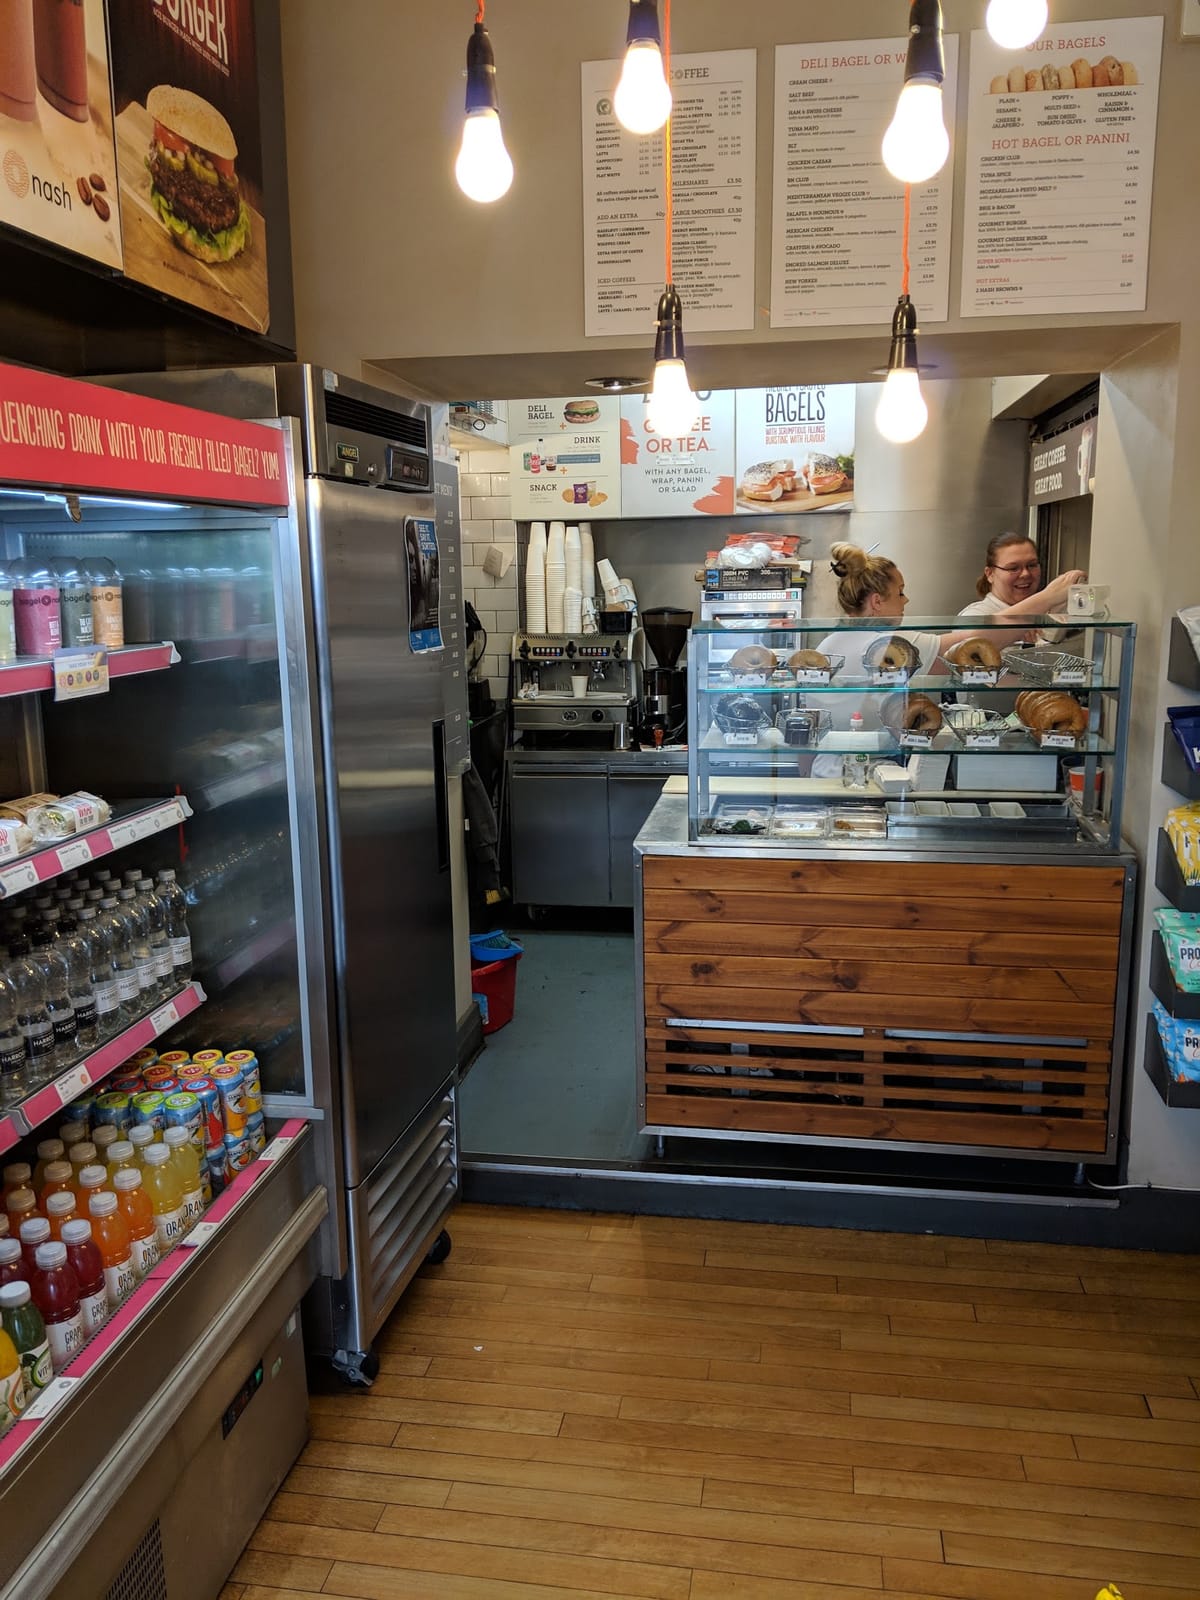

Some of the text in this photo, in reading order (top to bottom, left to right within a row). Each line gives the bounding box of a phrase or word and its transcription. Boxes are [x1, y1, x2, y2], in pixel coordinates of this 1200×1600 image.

[1058, 36, 1106, 50] BAGELS
[801, 58, 828, 69] DELI
[832, 55, 870, 67] BAGEL
[874, 54, 891, 64] OR
[992, 133, 1130, 150] HOT BAGEL OR PANINI
[31, 174, 73, 211] nash
[979, 187, 1014, 195] MOZZARELLA
[527, 405, 547, 413] DELI
[765, 390, 826, 423] BAGELS
[527, 412, 555, 420] BAGEL
[643, 416, 711, 433] CEE
[765, 425, 826, 436] WITH SCRUMPTIOUS FILLINGS
[574, 436, 601, 444] DRINK
[646, 436, 709, 453] OR TEA
[765, 435, 788, 445] BURSTING
[790, 434, 804, 444] WITH
[68, 412, 105, 456] DRINK
[105, 419, 138, 460] WITH
[138, 425, 167, 464] YOUR
[168, 431, 203, 471] FRESHLY
[205, 438, 232, 474] FILLED
[232, 444, 260, 479] BAGEL?
[261, 450, 281, 481] YUM!
[342, 447, 358, 458] ANGEL
[1034, 451, 1049, 472] GREAT
[644, 468, 664, 476] WITH
[684, 467, 711, 475] BAGEL,
[651, 477, 676, 485] WRAP,
[1034, 475, 1049, 496] GREAT
[529, 484, 557, 492] SNACK
[671, 485, 697, 493] SALAD
